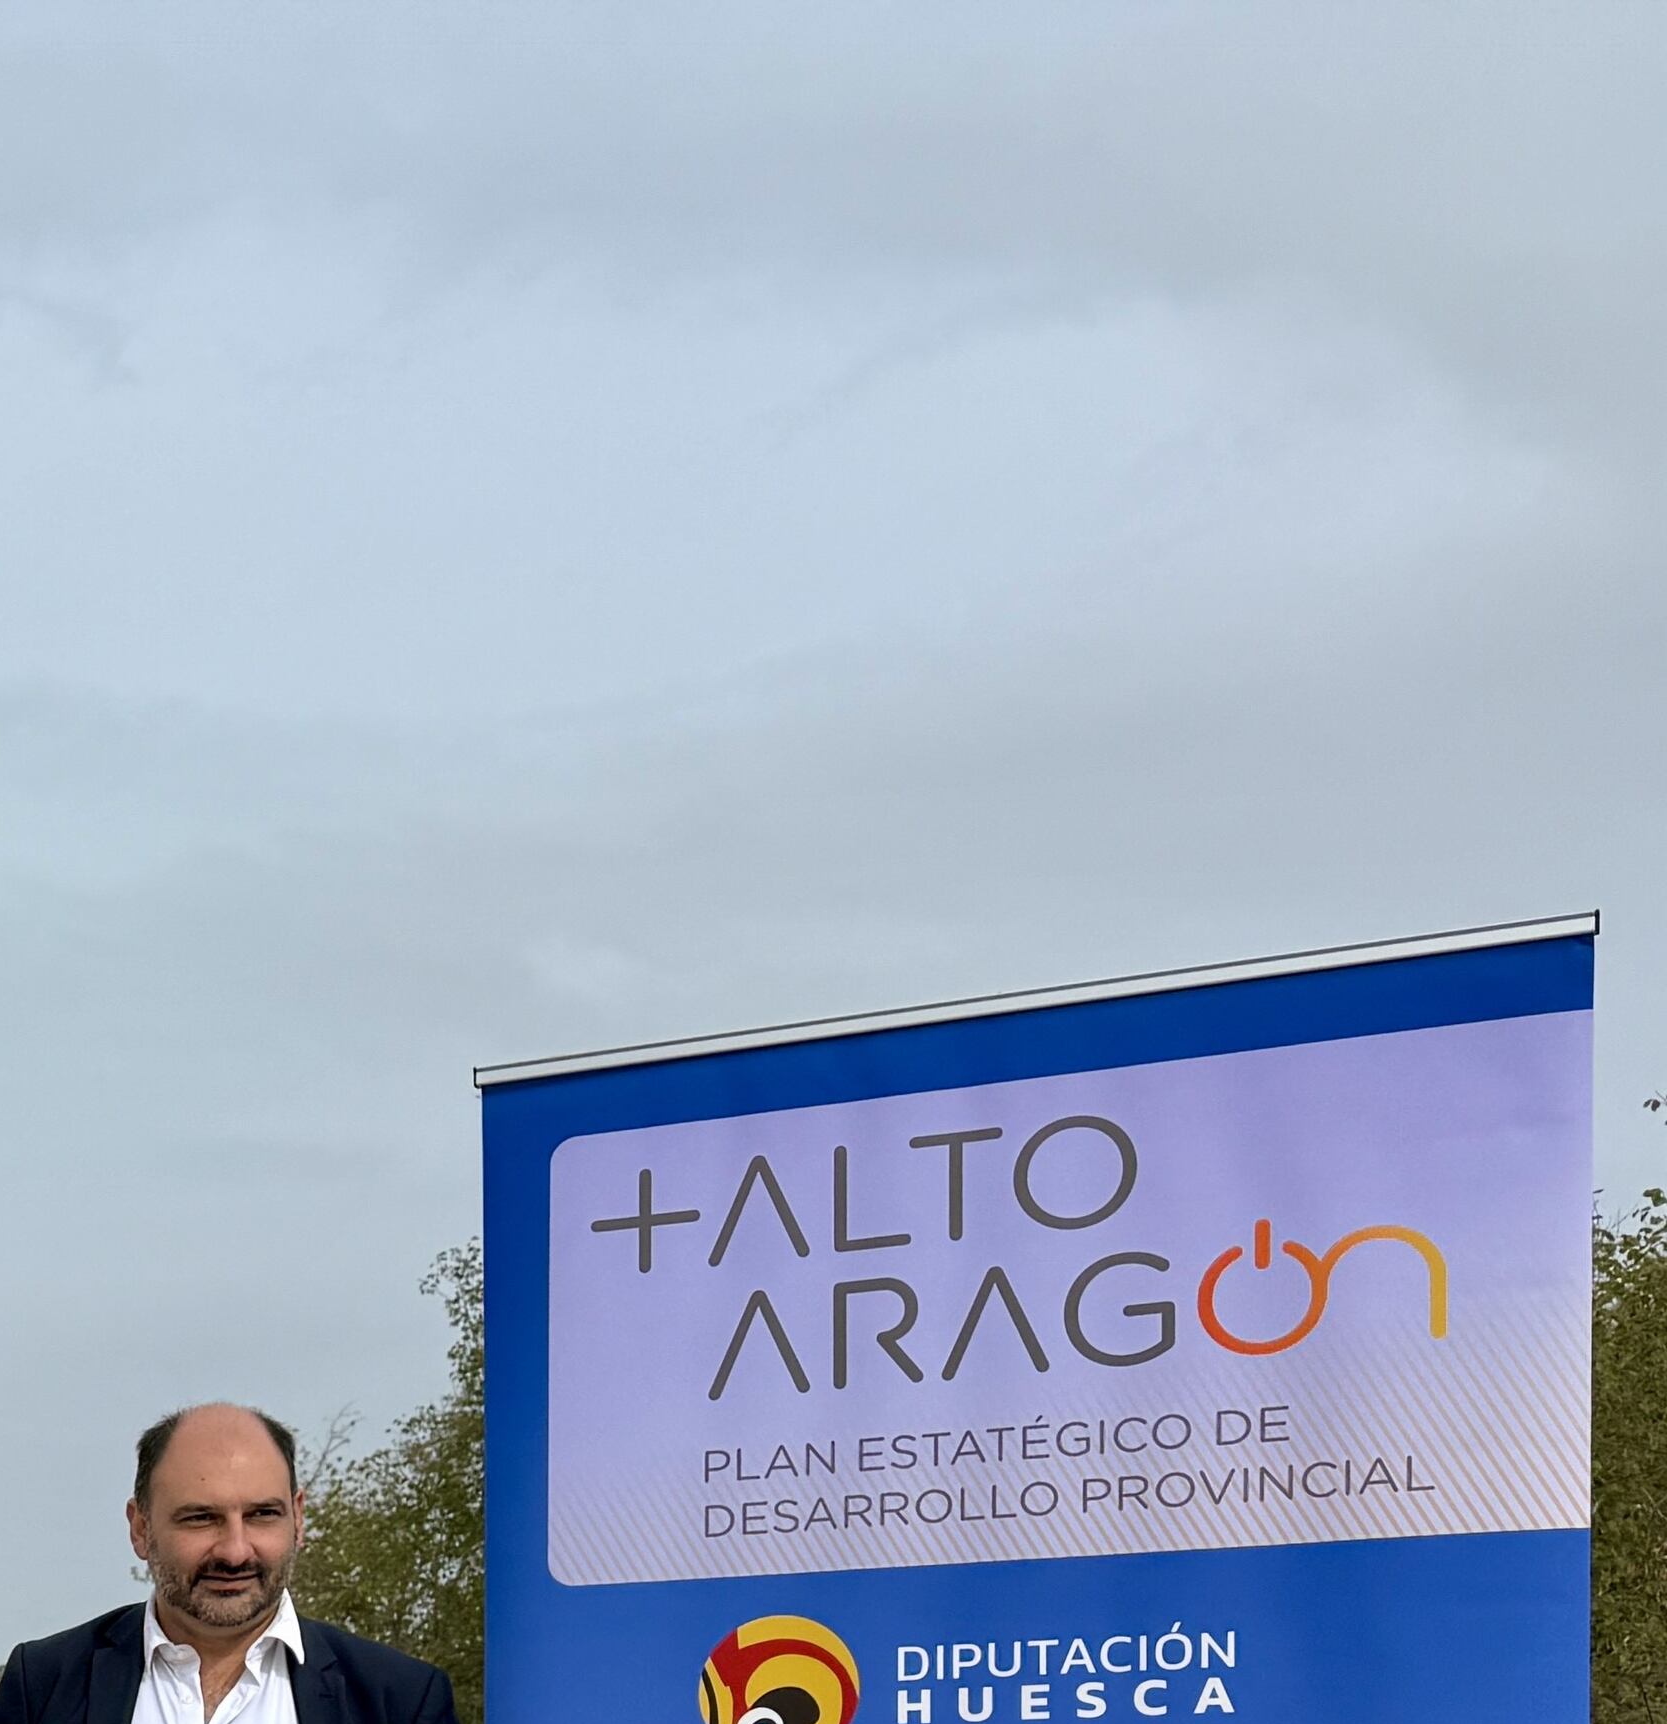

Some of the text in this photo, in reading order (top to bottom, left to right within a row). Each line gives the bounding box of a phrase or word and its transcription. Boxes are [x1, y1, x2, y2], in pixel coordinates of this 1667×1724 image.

[705, 1406, 1289, 1483] PLAN ESTATÉGICO DE
[705, 1456, 1435, 1538] DESARROLLO PROVINCIAL
[898, 1622, 1235, 1681] DIPUTACIÓN
[898, 1677, 1234, 1724] HUESCA
